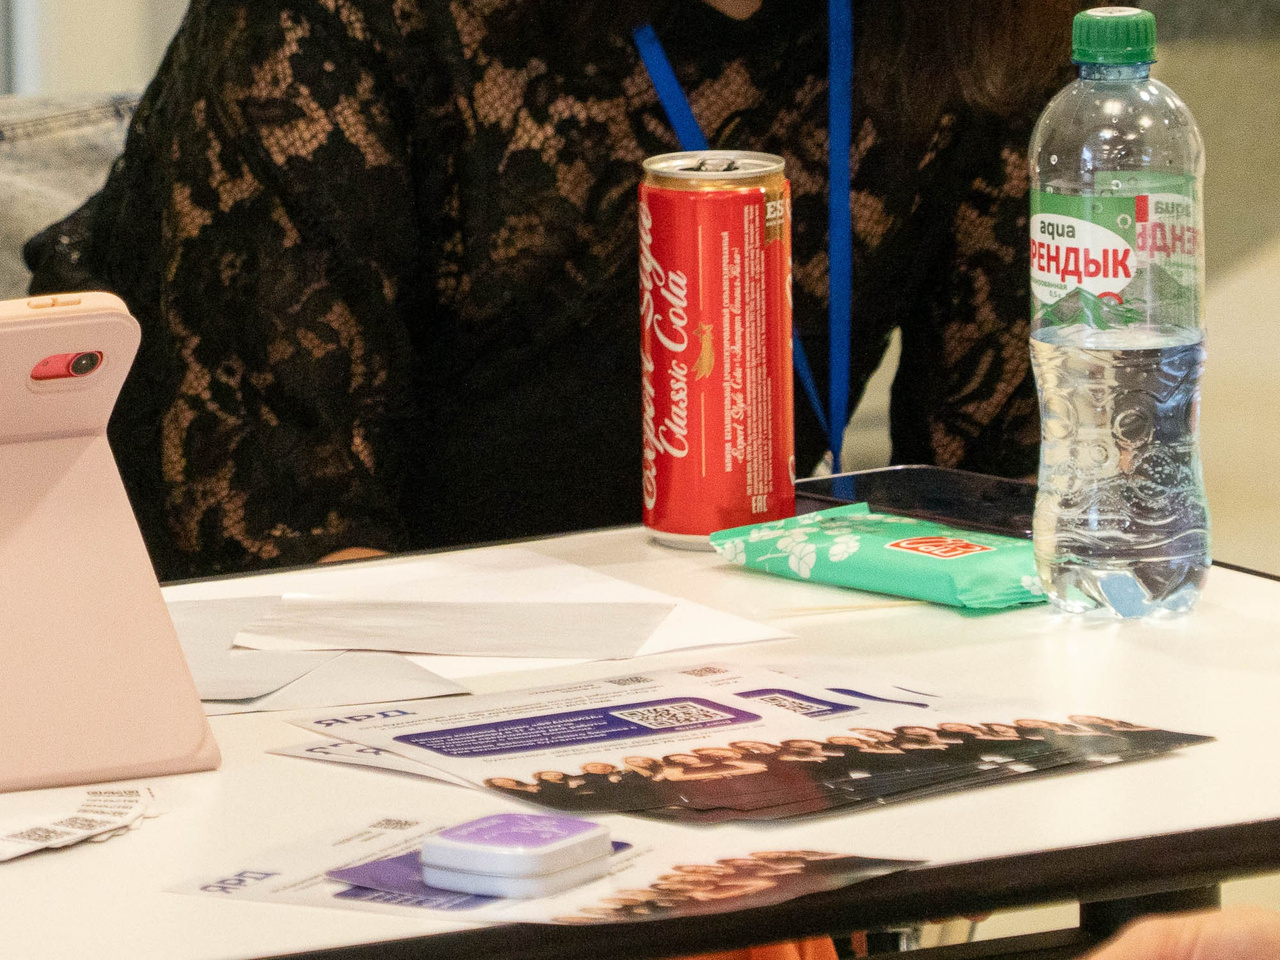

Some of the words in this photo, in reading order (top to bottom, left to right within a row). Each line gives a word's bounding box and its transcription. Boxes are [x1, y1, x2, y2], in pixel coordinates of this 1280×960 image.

[1039, 220, 1076, 240] aqua
[653, 270, 689, 352] Cola
[658, 359, 689, 459] Classic
[313, 709, 418, 727] ЯРД
[200, 870, 282, 894] ЯРД
